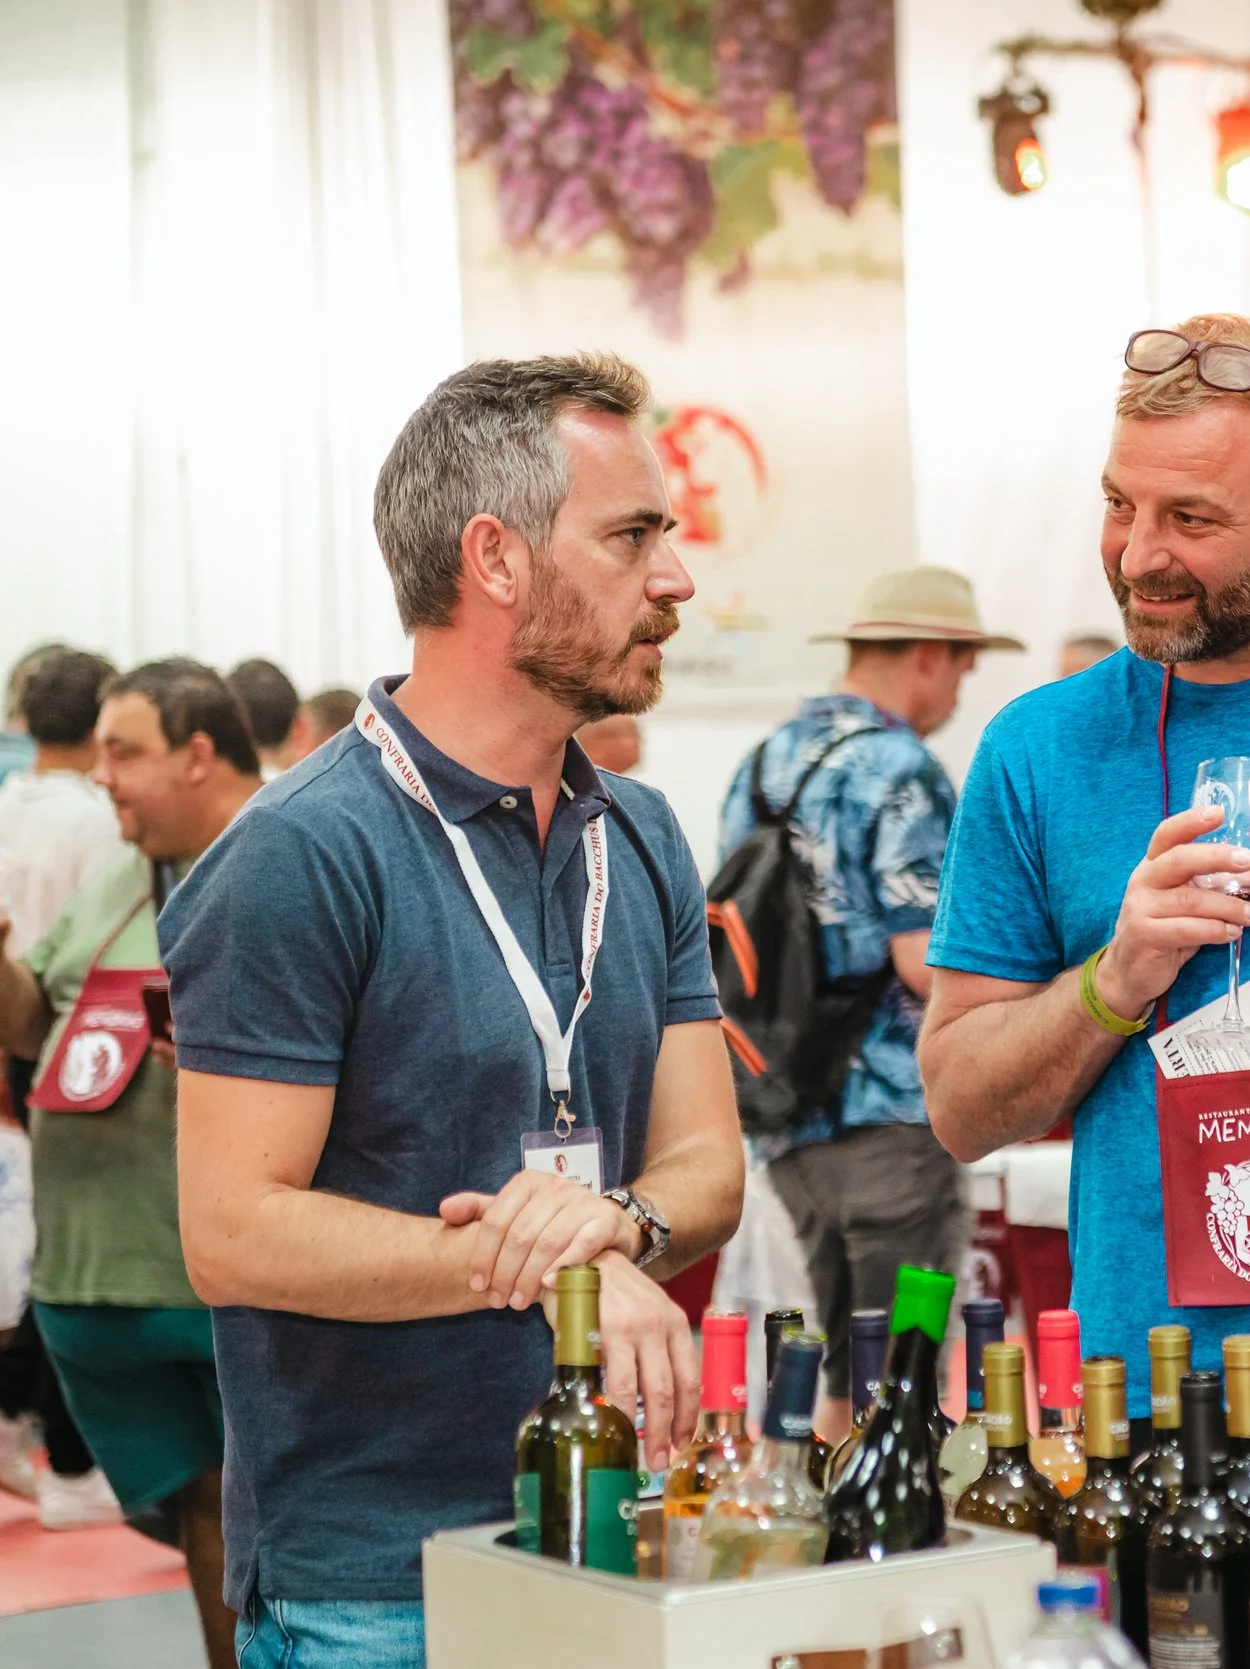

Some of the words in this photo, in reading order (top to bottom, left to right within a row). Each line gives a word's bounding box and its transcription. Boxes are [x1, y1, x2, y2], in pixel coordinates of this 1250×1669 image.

[376, 727, 421, 794] CONFRARIA
[588, 827, 603, 881] BACCHUS
[594, 883, 604, 902] DO
[585, 907, 601, 978] CONFRARIA
[1206, 1212, 1238, 1273] CONFRARIA
